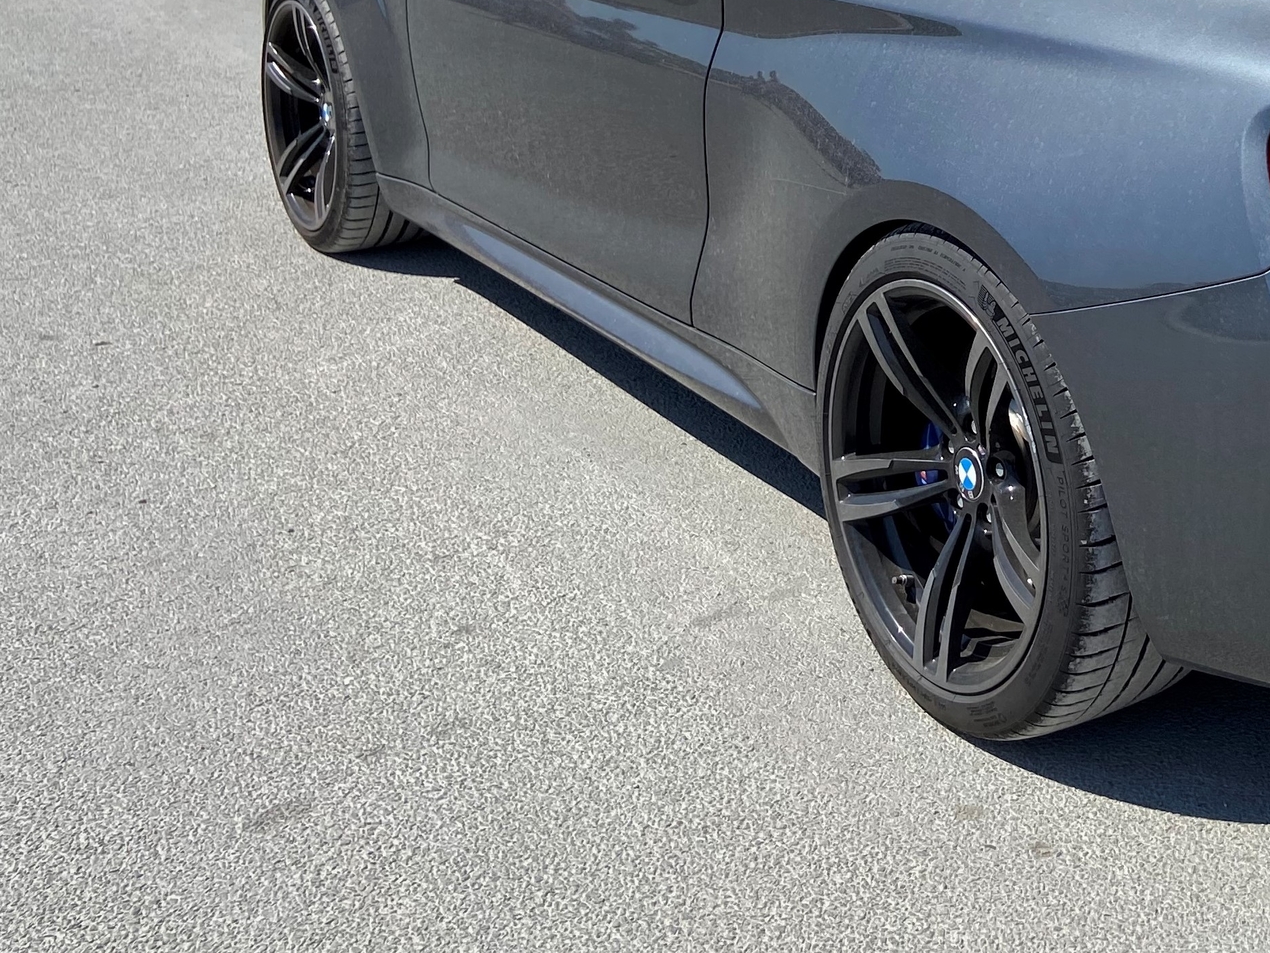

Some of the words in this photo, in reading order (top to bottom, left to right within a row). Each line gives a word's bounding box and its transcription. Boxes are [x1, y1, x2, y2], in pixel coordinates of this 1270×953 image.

[997, 315, 1060, 455] MICHELIN
[1056, 475, 1069, 519] PILOT
[1061, 524, 1070, 575] SPORT
